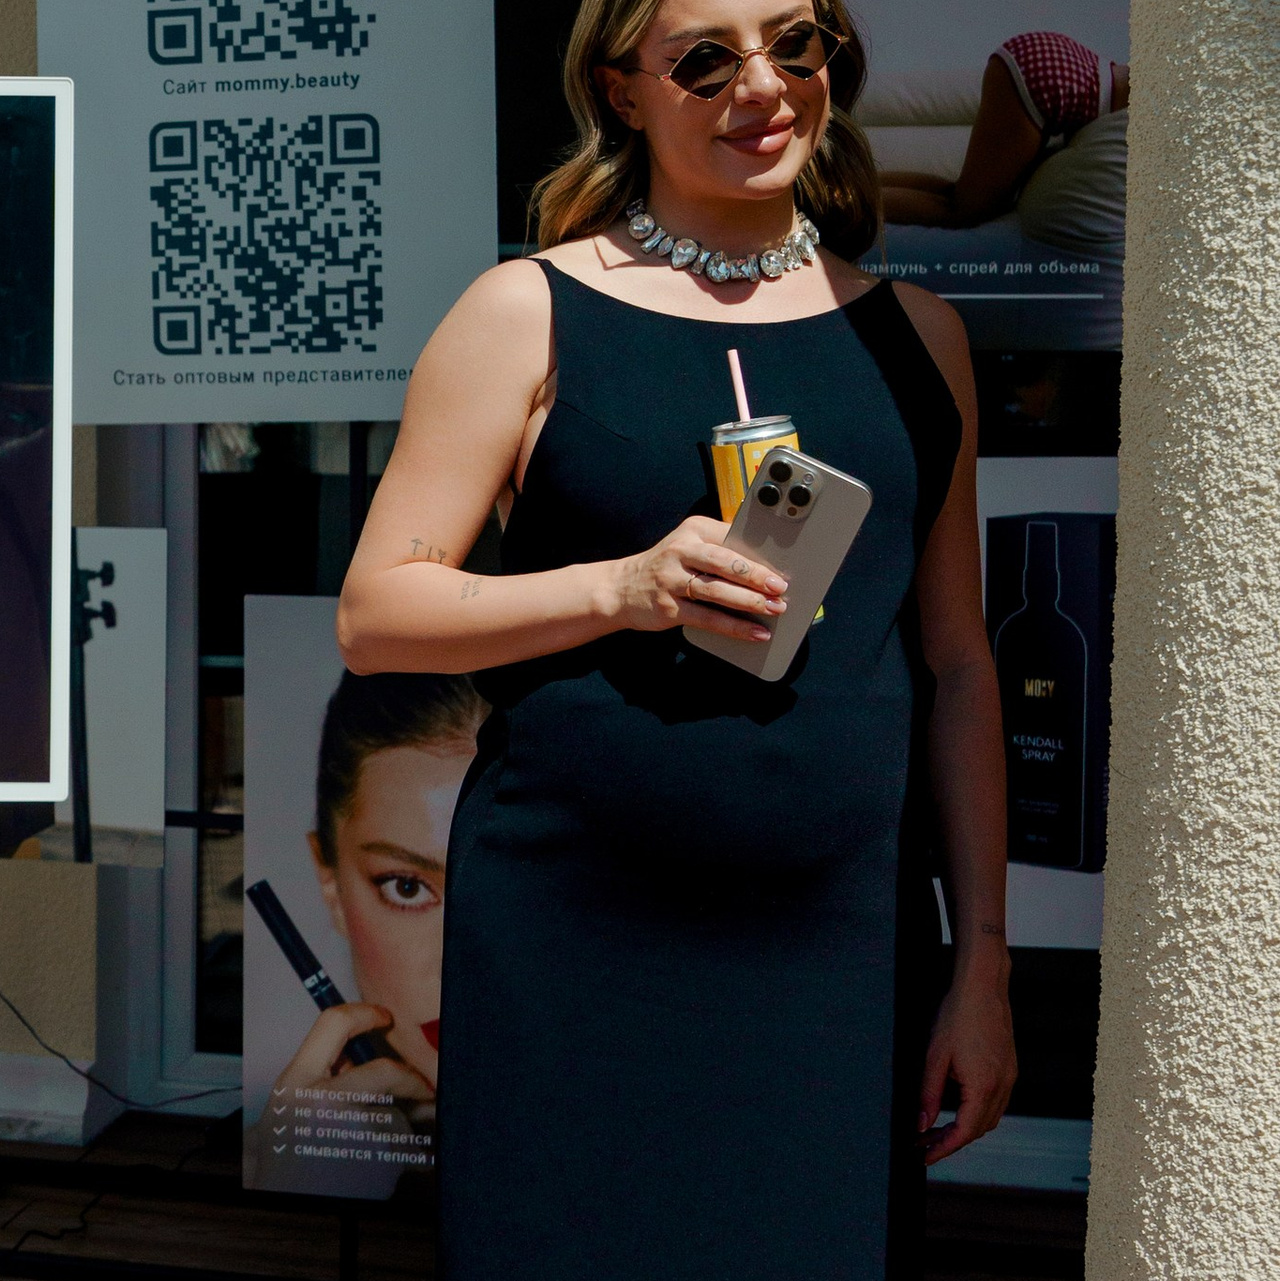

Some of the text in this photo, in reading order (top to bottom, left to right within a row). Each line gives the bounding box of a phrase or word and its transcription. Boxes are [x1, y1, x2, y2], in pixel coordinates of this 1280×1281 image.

[163, 71, 360, 95] Сайт mommy.beauty
[949, 260, 997, 277] спрей
[1004, 263, 1032, 275] для
[113, 367, 414, 387] Стать оптовым представителе
[1012, 734, 1065, 751] KENDALL
[1021, 749, 1057, 763] SPRAY
[295, 1087, 394, 1105] влагостойкая
[295, 1107, 393, 1124] не осыпается
[295, 1126, 431, 1146] не отпечатывается
[294, 1143, 371, 1160] смывается
